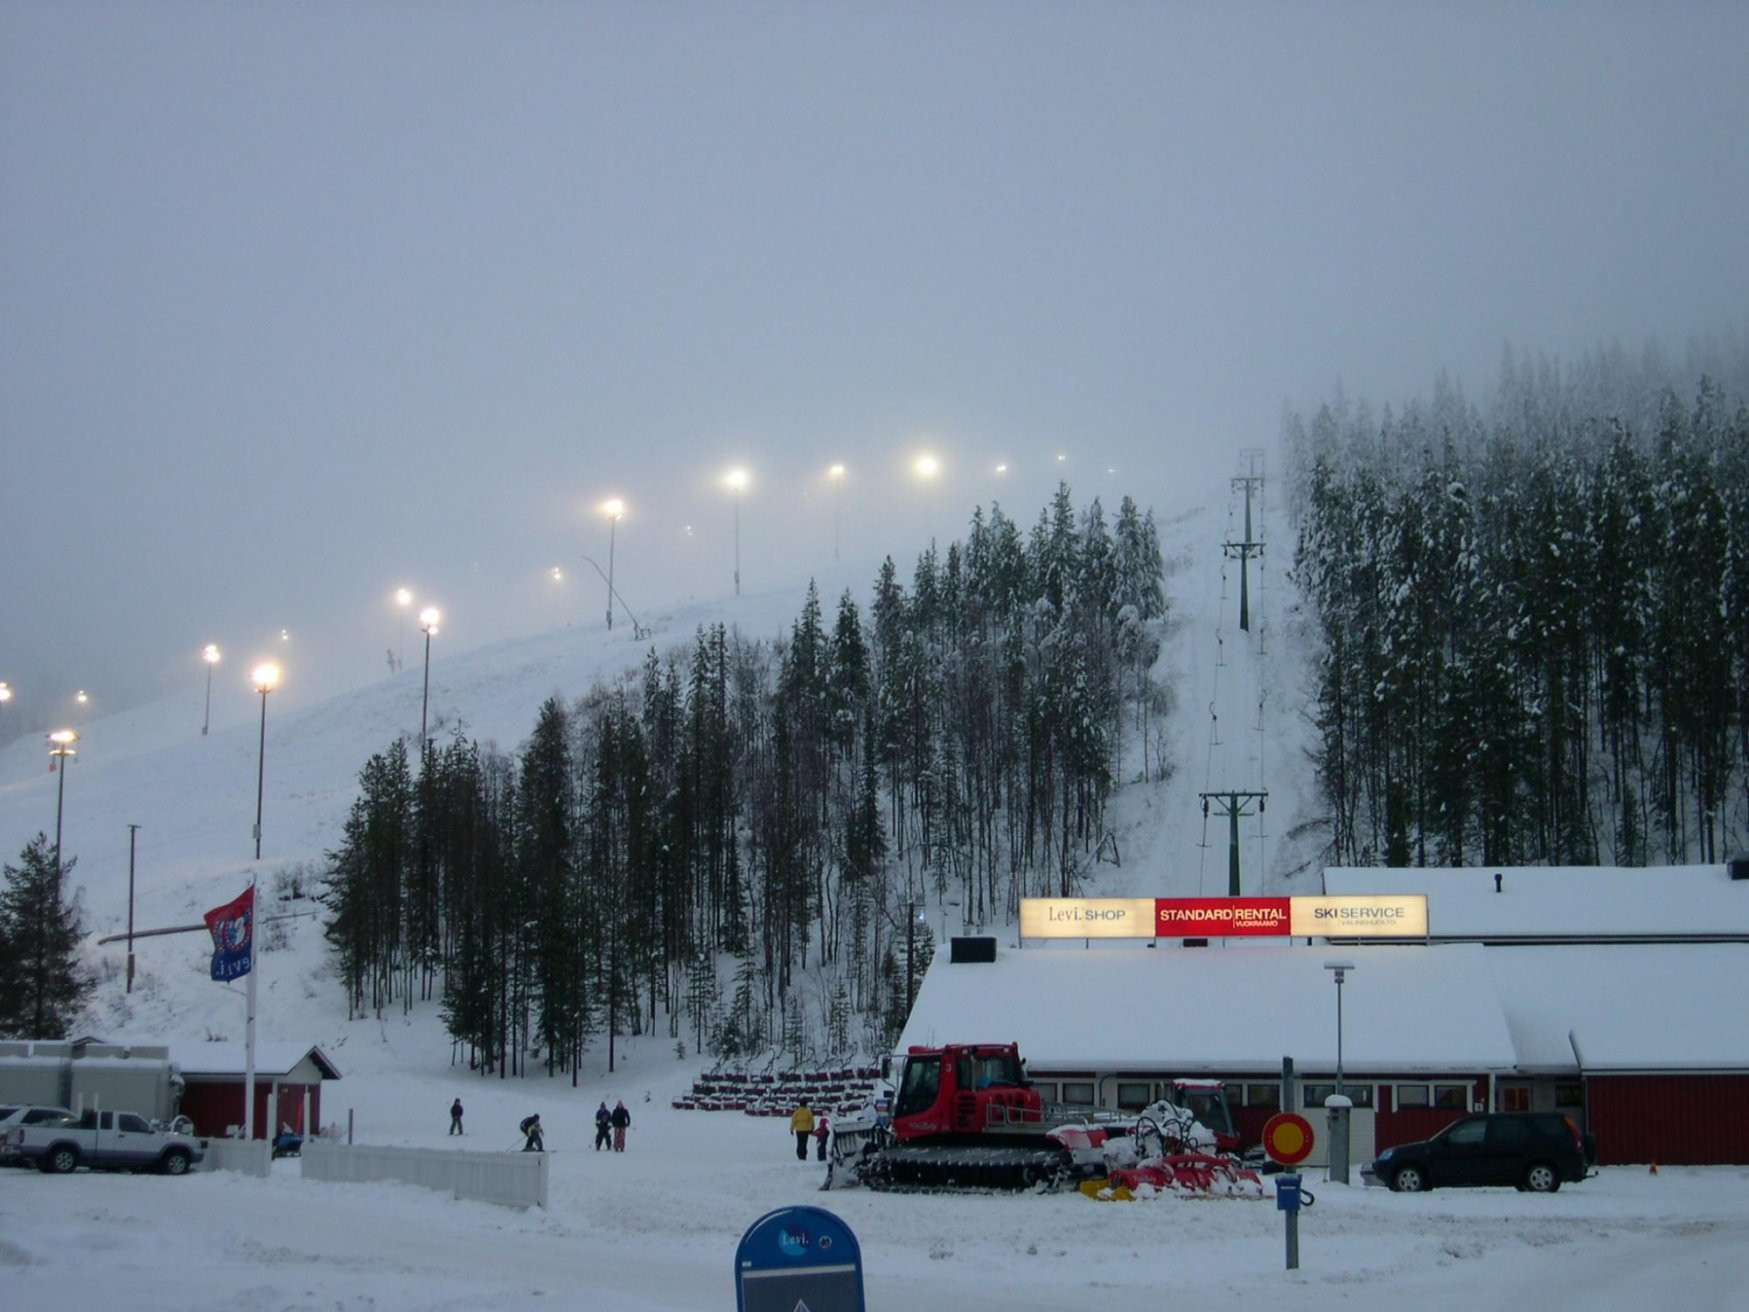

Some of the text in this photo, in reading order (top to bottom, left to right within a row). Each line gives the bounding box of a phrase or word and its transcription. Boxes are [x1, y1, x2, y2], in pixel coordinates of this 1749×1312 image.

[1084, 909, 1126, 921] SHOP
[1160, 908, 1287, 921] STANDARD RENTAL
[1314, 907, 1405, 919] SKI SERVICE
